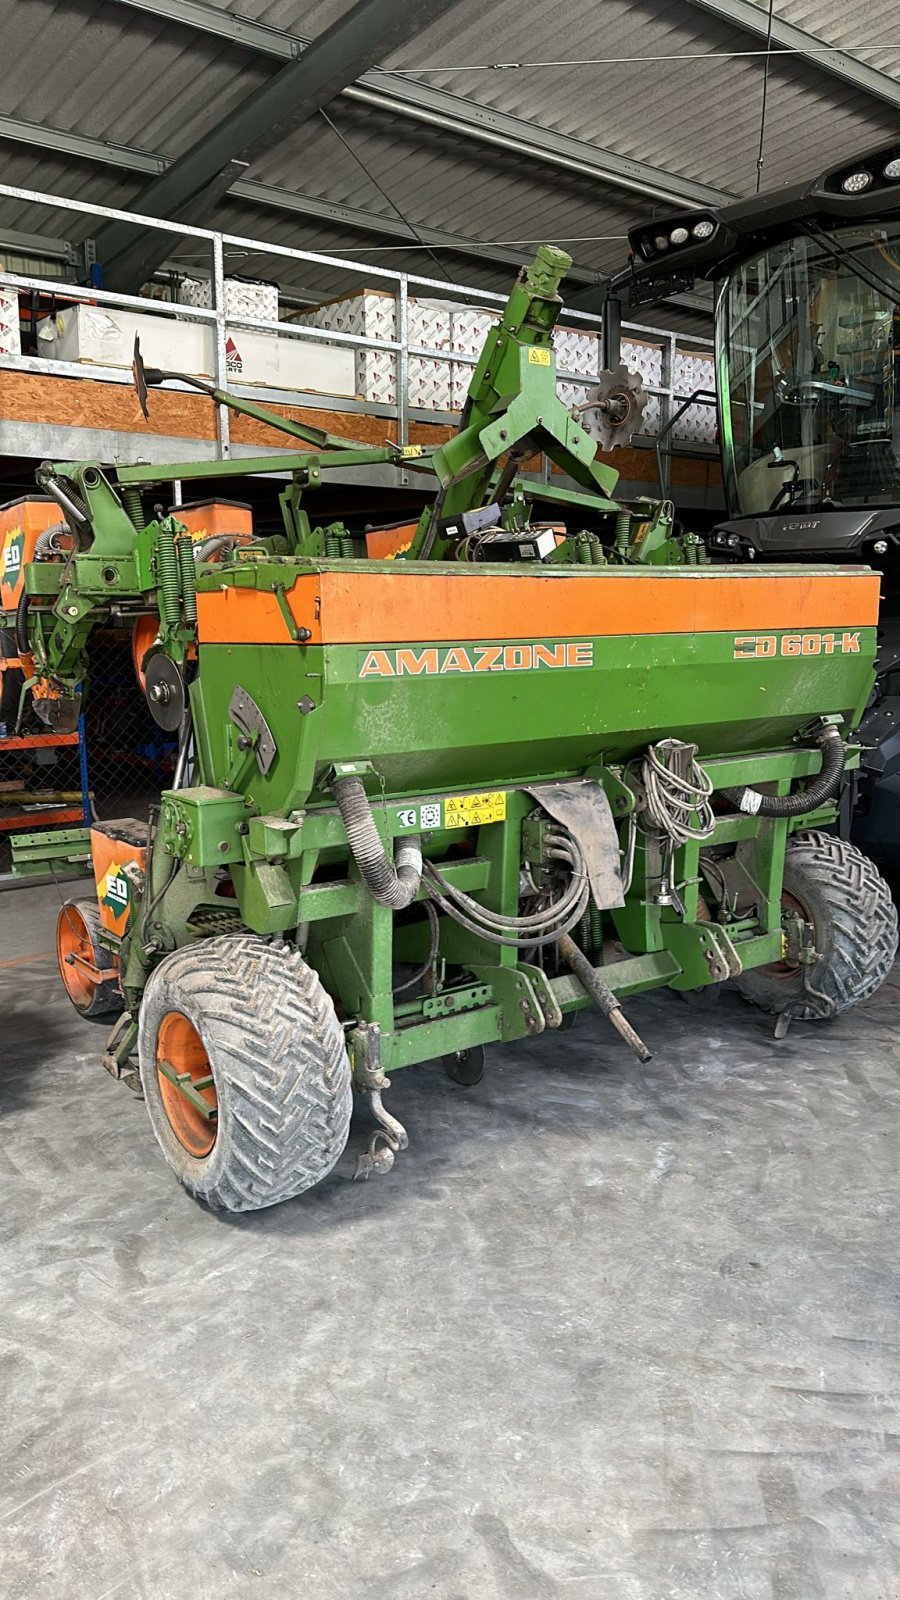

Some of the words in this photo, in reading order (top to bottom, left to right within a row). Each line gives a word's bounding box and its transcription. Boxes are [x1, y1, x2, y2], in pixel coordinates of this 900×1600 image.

[4, 545, 20, 566] ED
[734, 636, 777, 659] ED
[781, 632, 860, 656] 601-K
[359, 642, 593, 677] AMAZONE
[105, 874, 128, 900] ED
